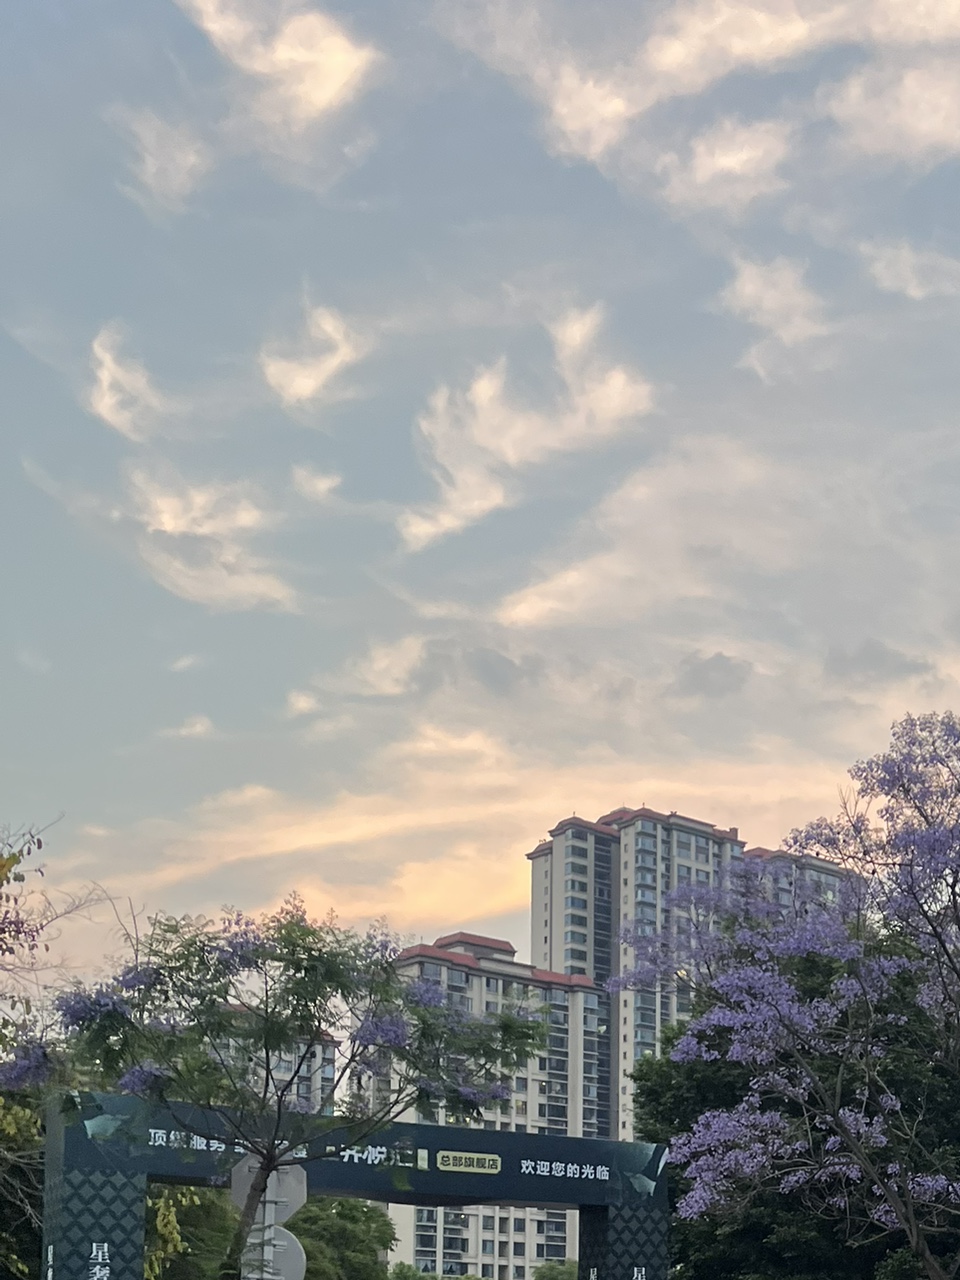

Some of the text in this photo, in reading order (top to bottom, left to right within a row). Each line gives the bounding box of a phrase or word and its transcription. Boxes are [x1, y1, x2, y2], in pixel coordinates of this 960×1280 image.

[439, 1154, 499, 1171] 总部旗舰店
[520, 1159, 610, 1181] 欢迎您的光临
